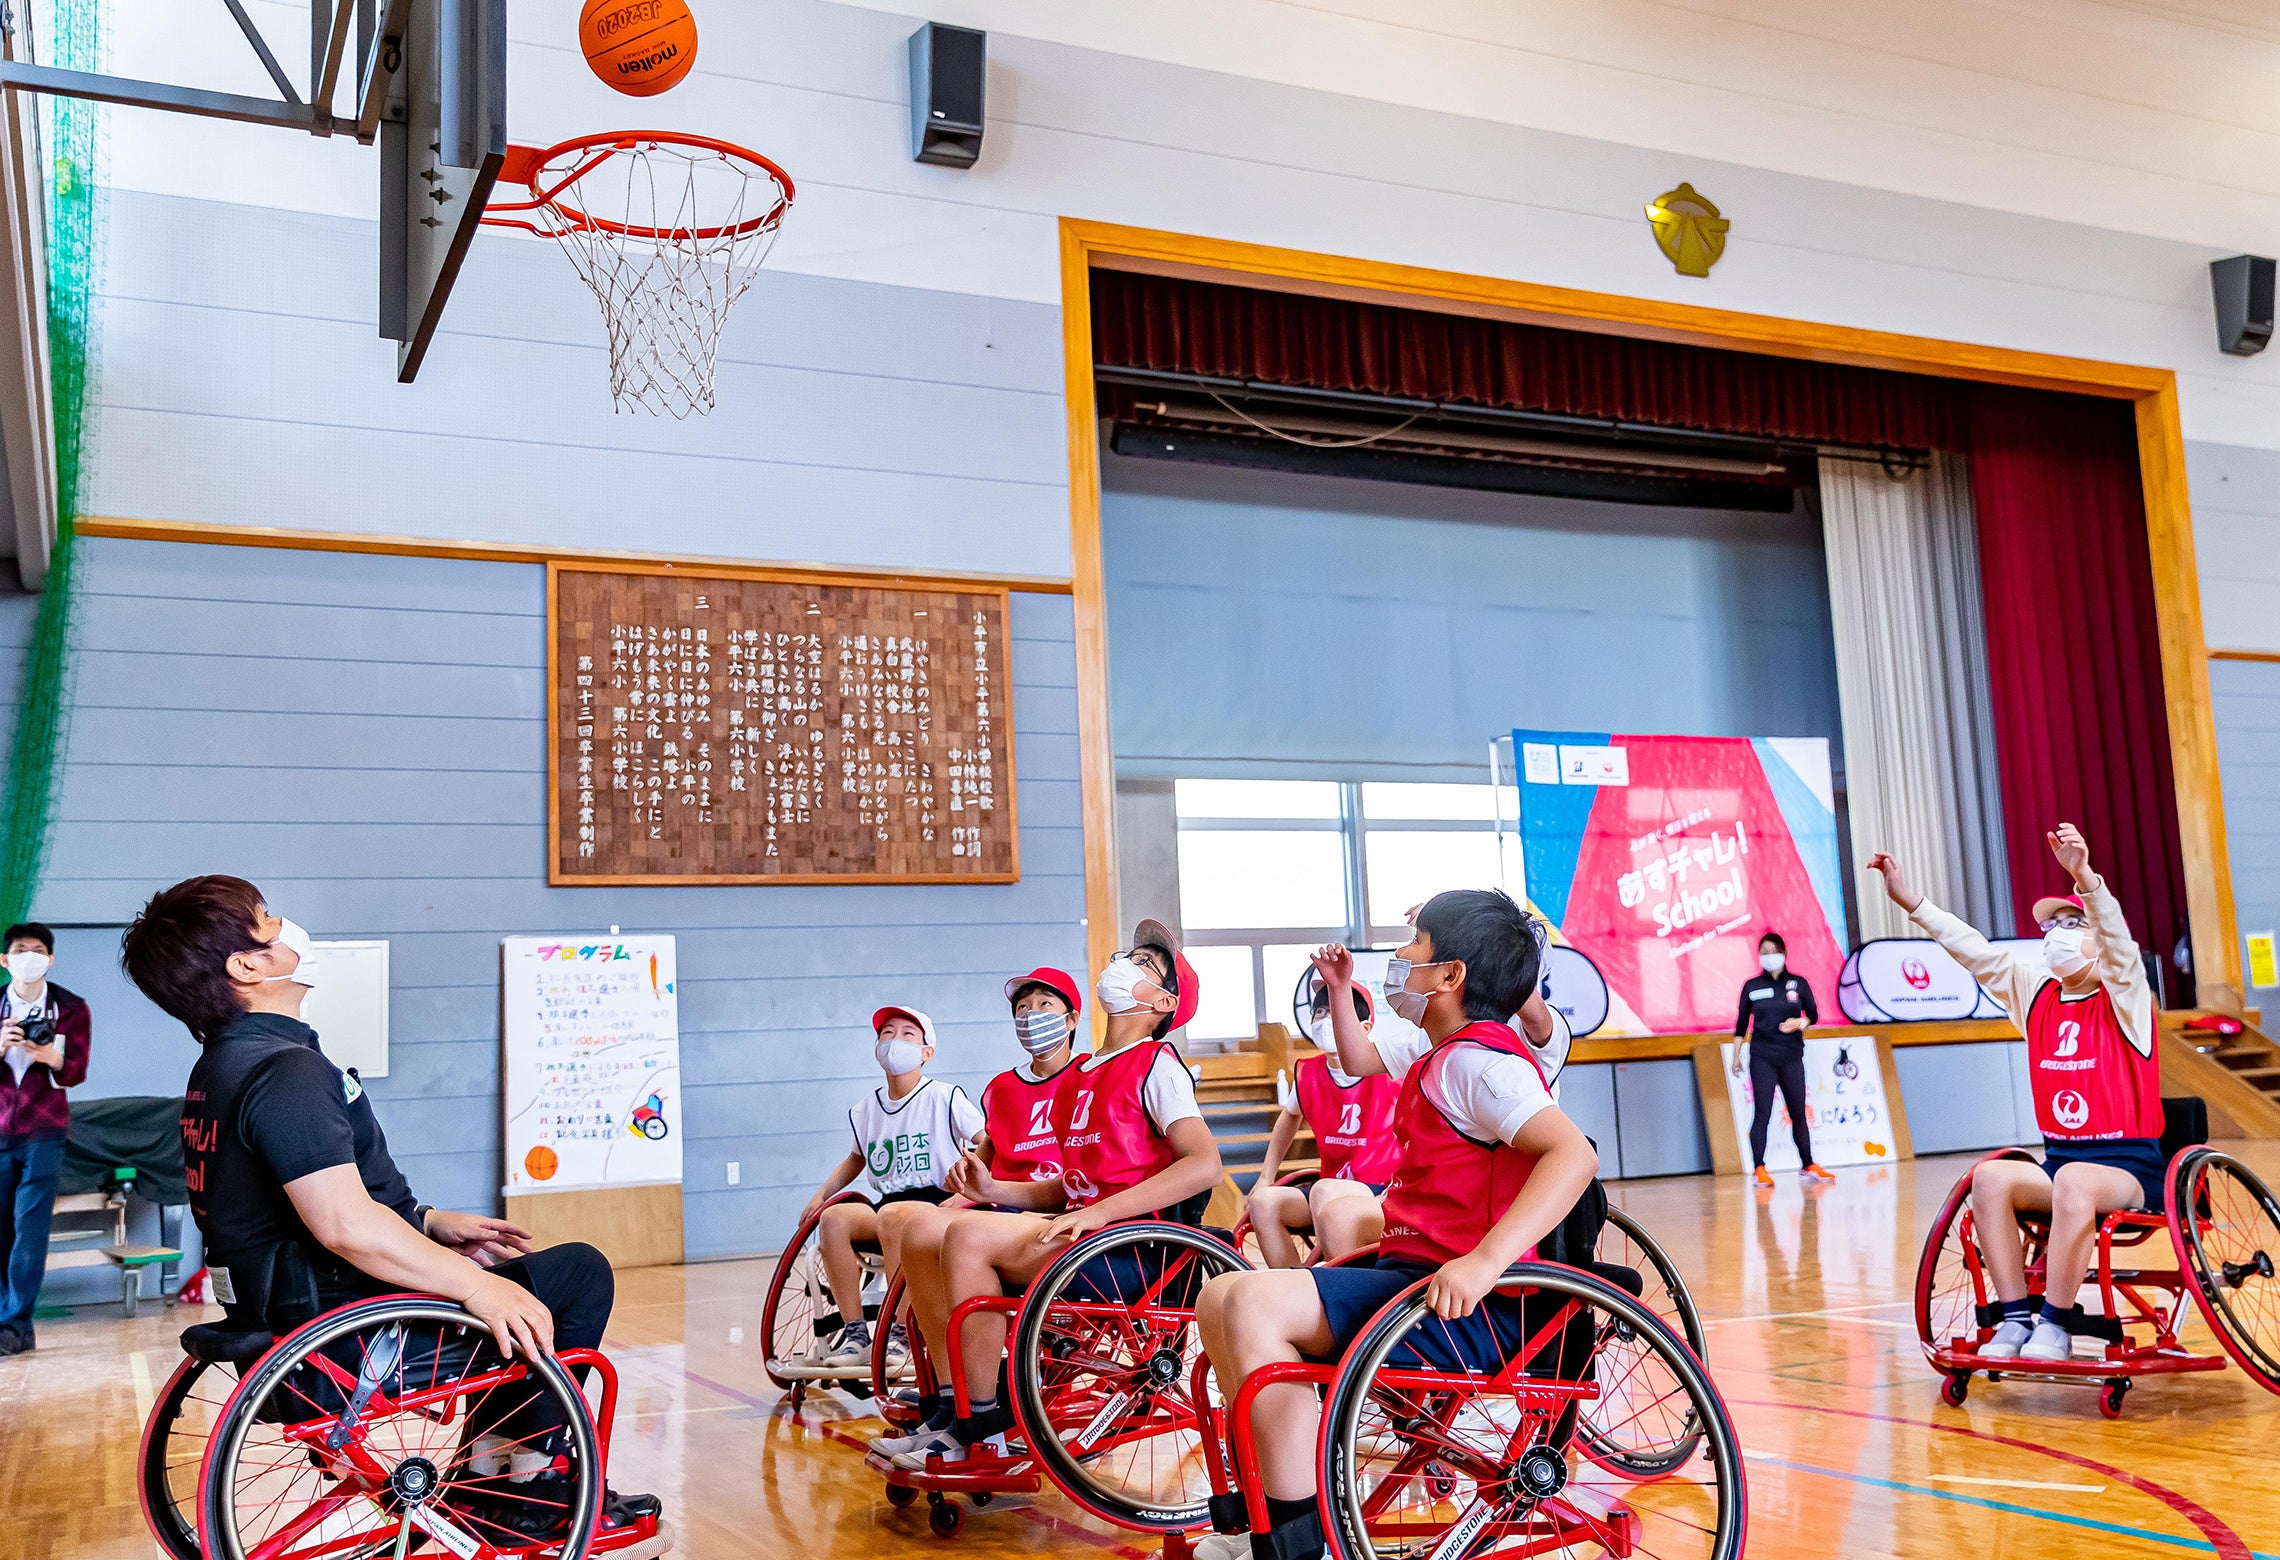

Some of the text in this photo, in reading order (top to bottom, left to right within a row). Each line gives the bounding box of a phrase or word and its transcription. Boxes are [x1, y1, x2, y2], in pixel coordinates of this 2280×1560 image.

[597, 0, 662, 39] JB2020
[617, 43, 678, 74] molten
[695, 595, 710, 609] 三
[806, 603, 821, 615] 二
[609, 624, 629, 790] 小平六小 第六小学校
[628, 625, 645, 823] はげもう常に ほこらしく
[645, 625, 663, 839] さあ未来の文化 この手にと
[679, 627, 697, 806] 日に日に伸びる 小平の
[695, 628, 713, 823] 日本のあゆみ そのままに
[727, 629, 746, 792] 小平六小 第六小学校
[760, 631, 779, 857] さあ理想と仰ぎ きょうもまた
[776, 633, 795, 824] ひときわ高く 浮かぶ富士
[792, 634, 811, 824] つらなる山の いただきに
[807, 633, 826, 808] 大空はるか ゆるぎなく
[838, 634, 857, 793] 小平六小 第六小学校
[870, 636, 889, 842] さあみなぎる光 あびながら
[915, 639, 935, 842] けやきのみどり さわやかな
[577, 655, 595, 858] 第四十三回卒業生卒業制作
[745, 726, 761, 775] 新しく
[857, 747, 873, 825] ほがらかに
[904, 731, 919, 807] ここにたつ
[951, 826, 966, 856] 作曲
[966, 826, 982, 858] 作詞
[1652, 866, 1744, 937] School
[537, 944, 631, 963] プログラム
[896, 1132, 929, 1153] 日本
[1013, 1136, 1058, 1153] BRIDGEST
[1063, 1132, 1101, 1149] GESTONE
[1821, 1104, 1878, 1125] になろう
